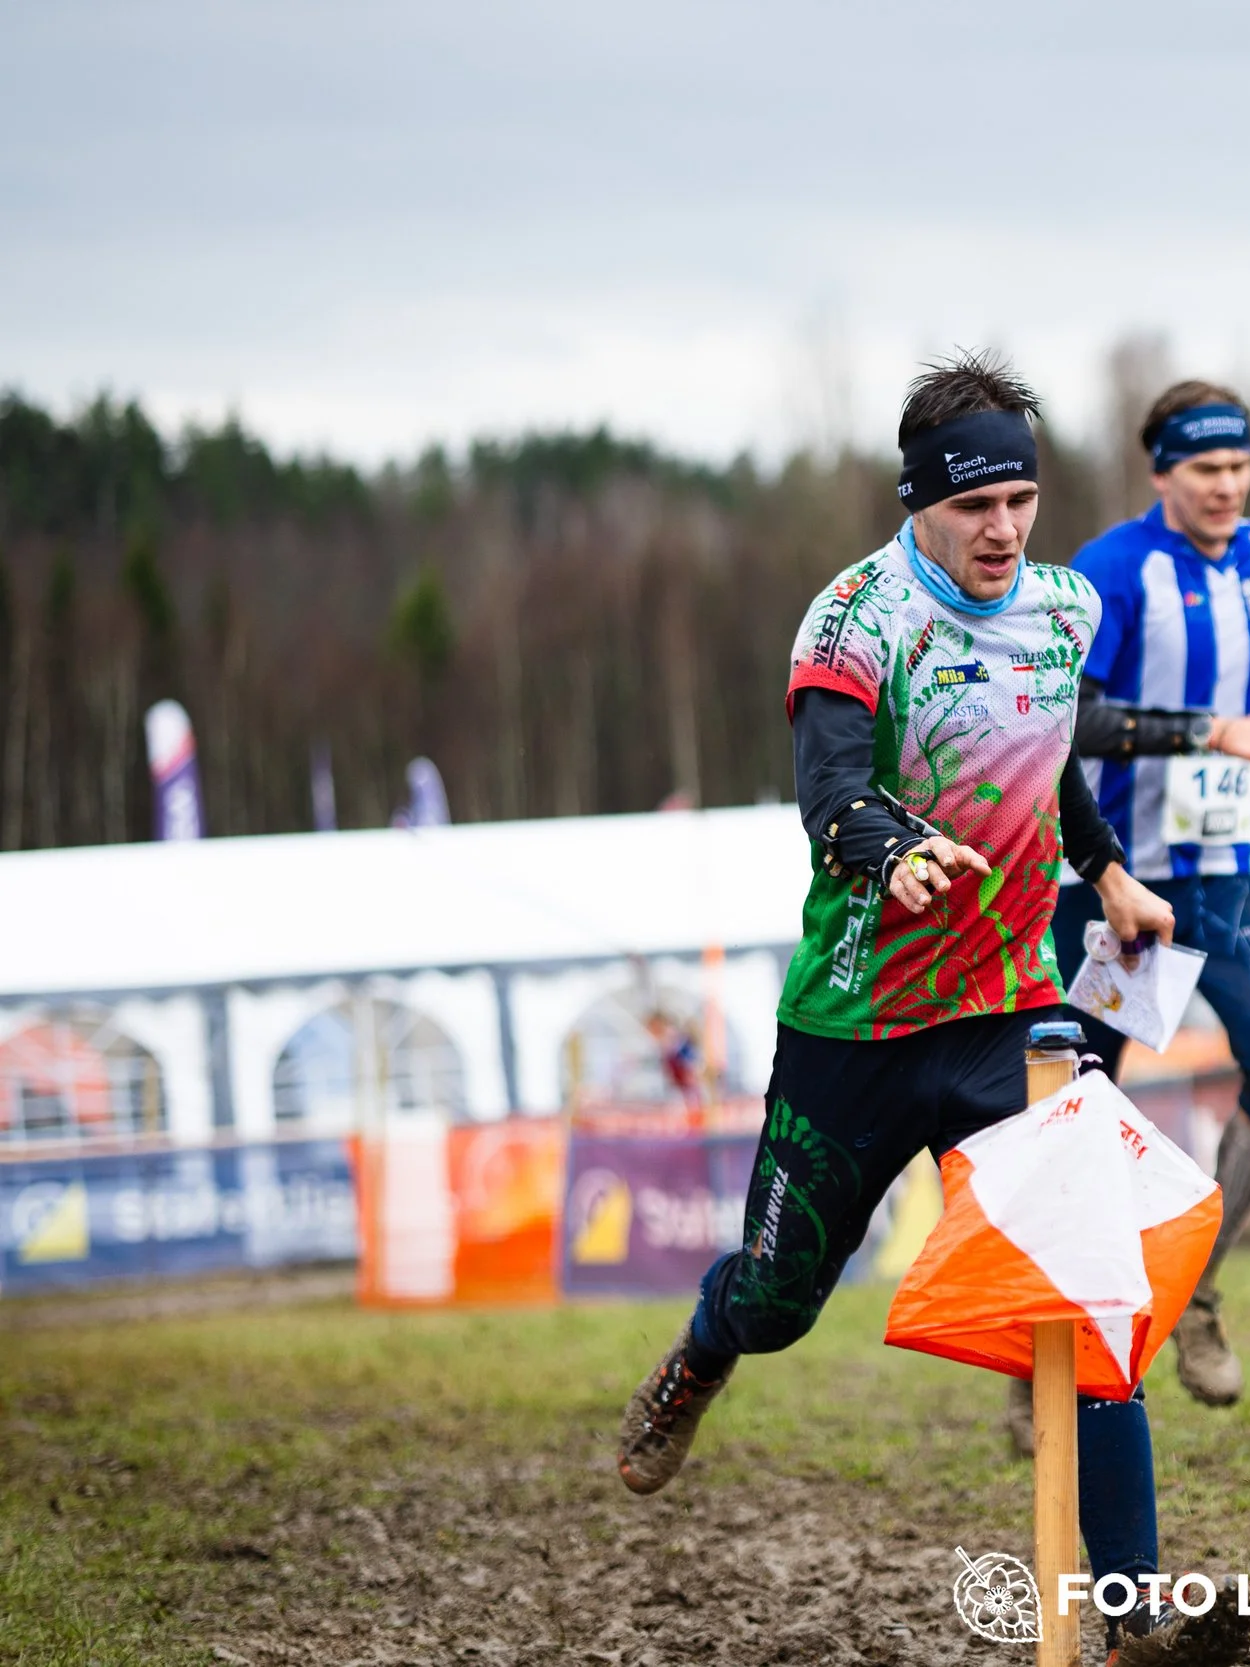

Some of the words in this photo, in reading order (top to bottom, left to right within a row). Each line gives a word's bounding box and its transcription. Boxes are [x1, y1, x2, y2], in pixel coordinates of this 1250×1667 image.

[948, 455, 987, 474] Czech
[951, 460, 1023, 484] Orienteering
[936, 668, 966, 685] Mila
[943, 704, 989, 718] RIKSTEN
[761, 1165, 790, 1263] TRIMTEX
